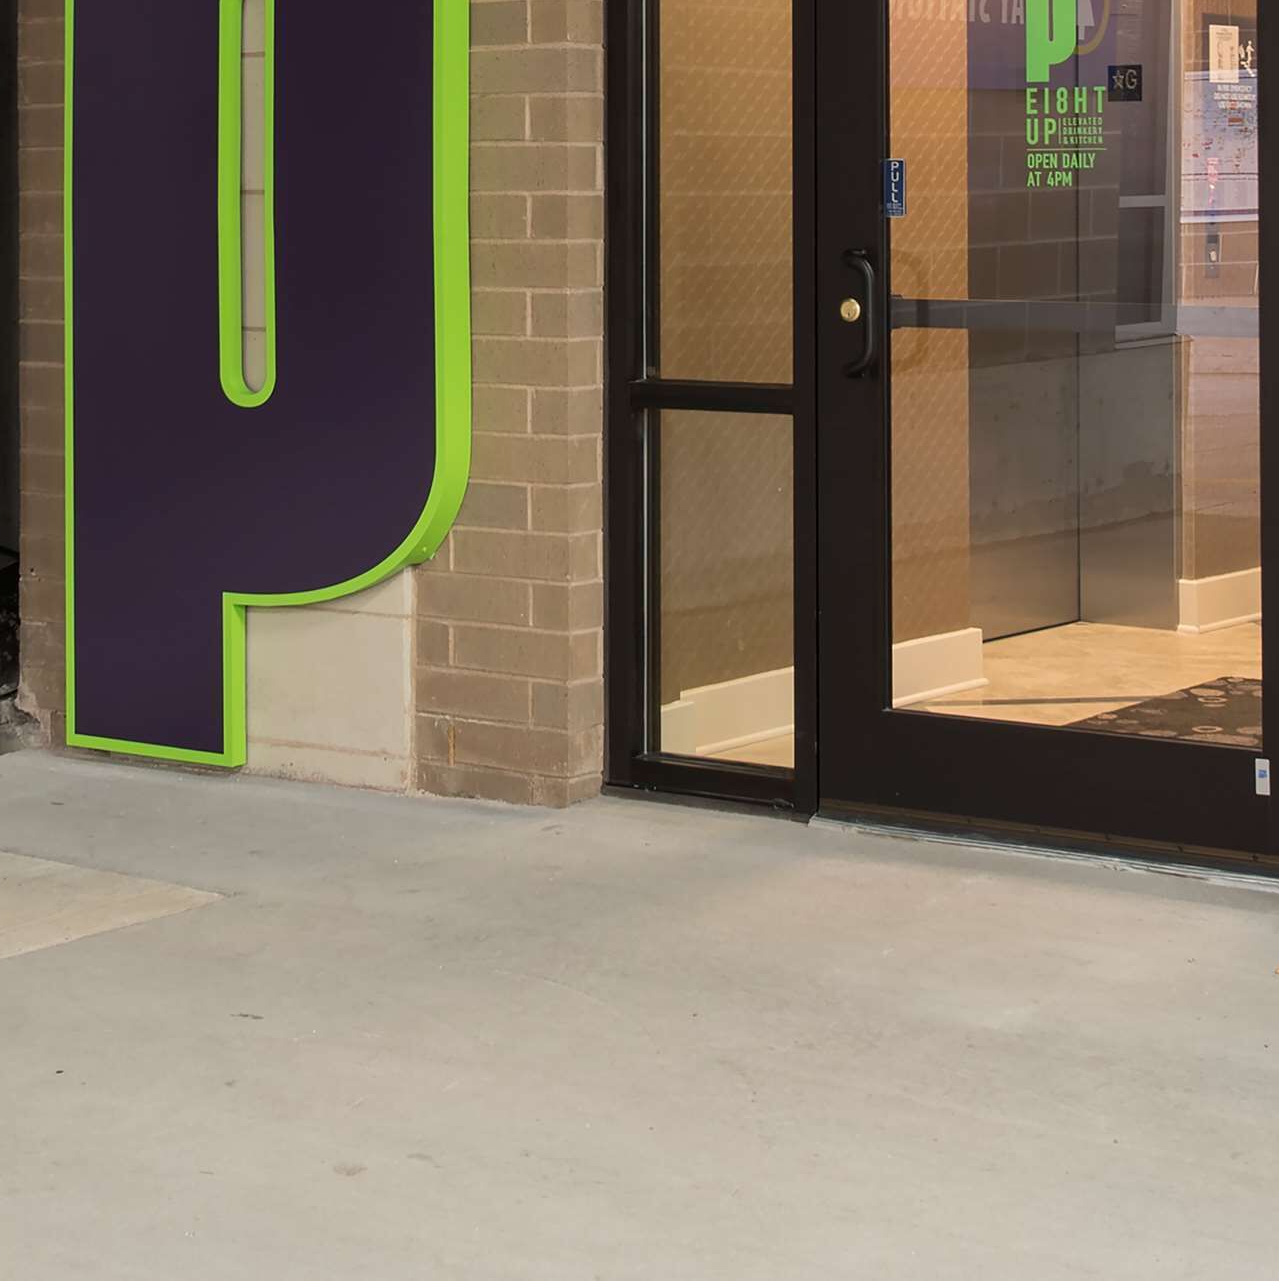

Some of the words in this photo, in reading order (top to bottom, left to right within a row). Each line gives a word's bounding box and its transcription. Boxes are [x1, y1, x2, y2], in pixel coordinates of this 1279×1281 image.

[1026, 118, 1057, 145] UP
[1027, 153, 1058, 169] OPEN
[1062, 153, 1096, 169] DAILY
[891, 161, 900, 203] PULL
[1027, 171, 1041, 187] AT
[1047, 171, 1073, 187] 4PM
